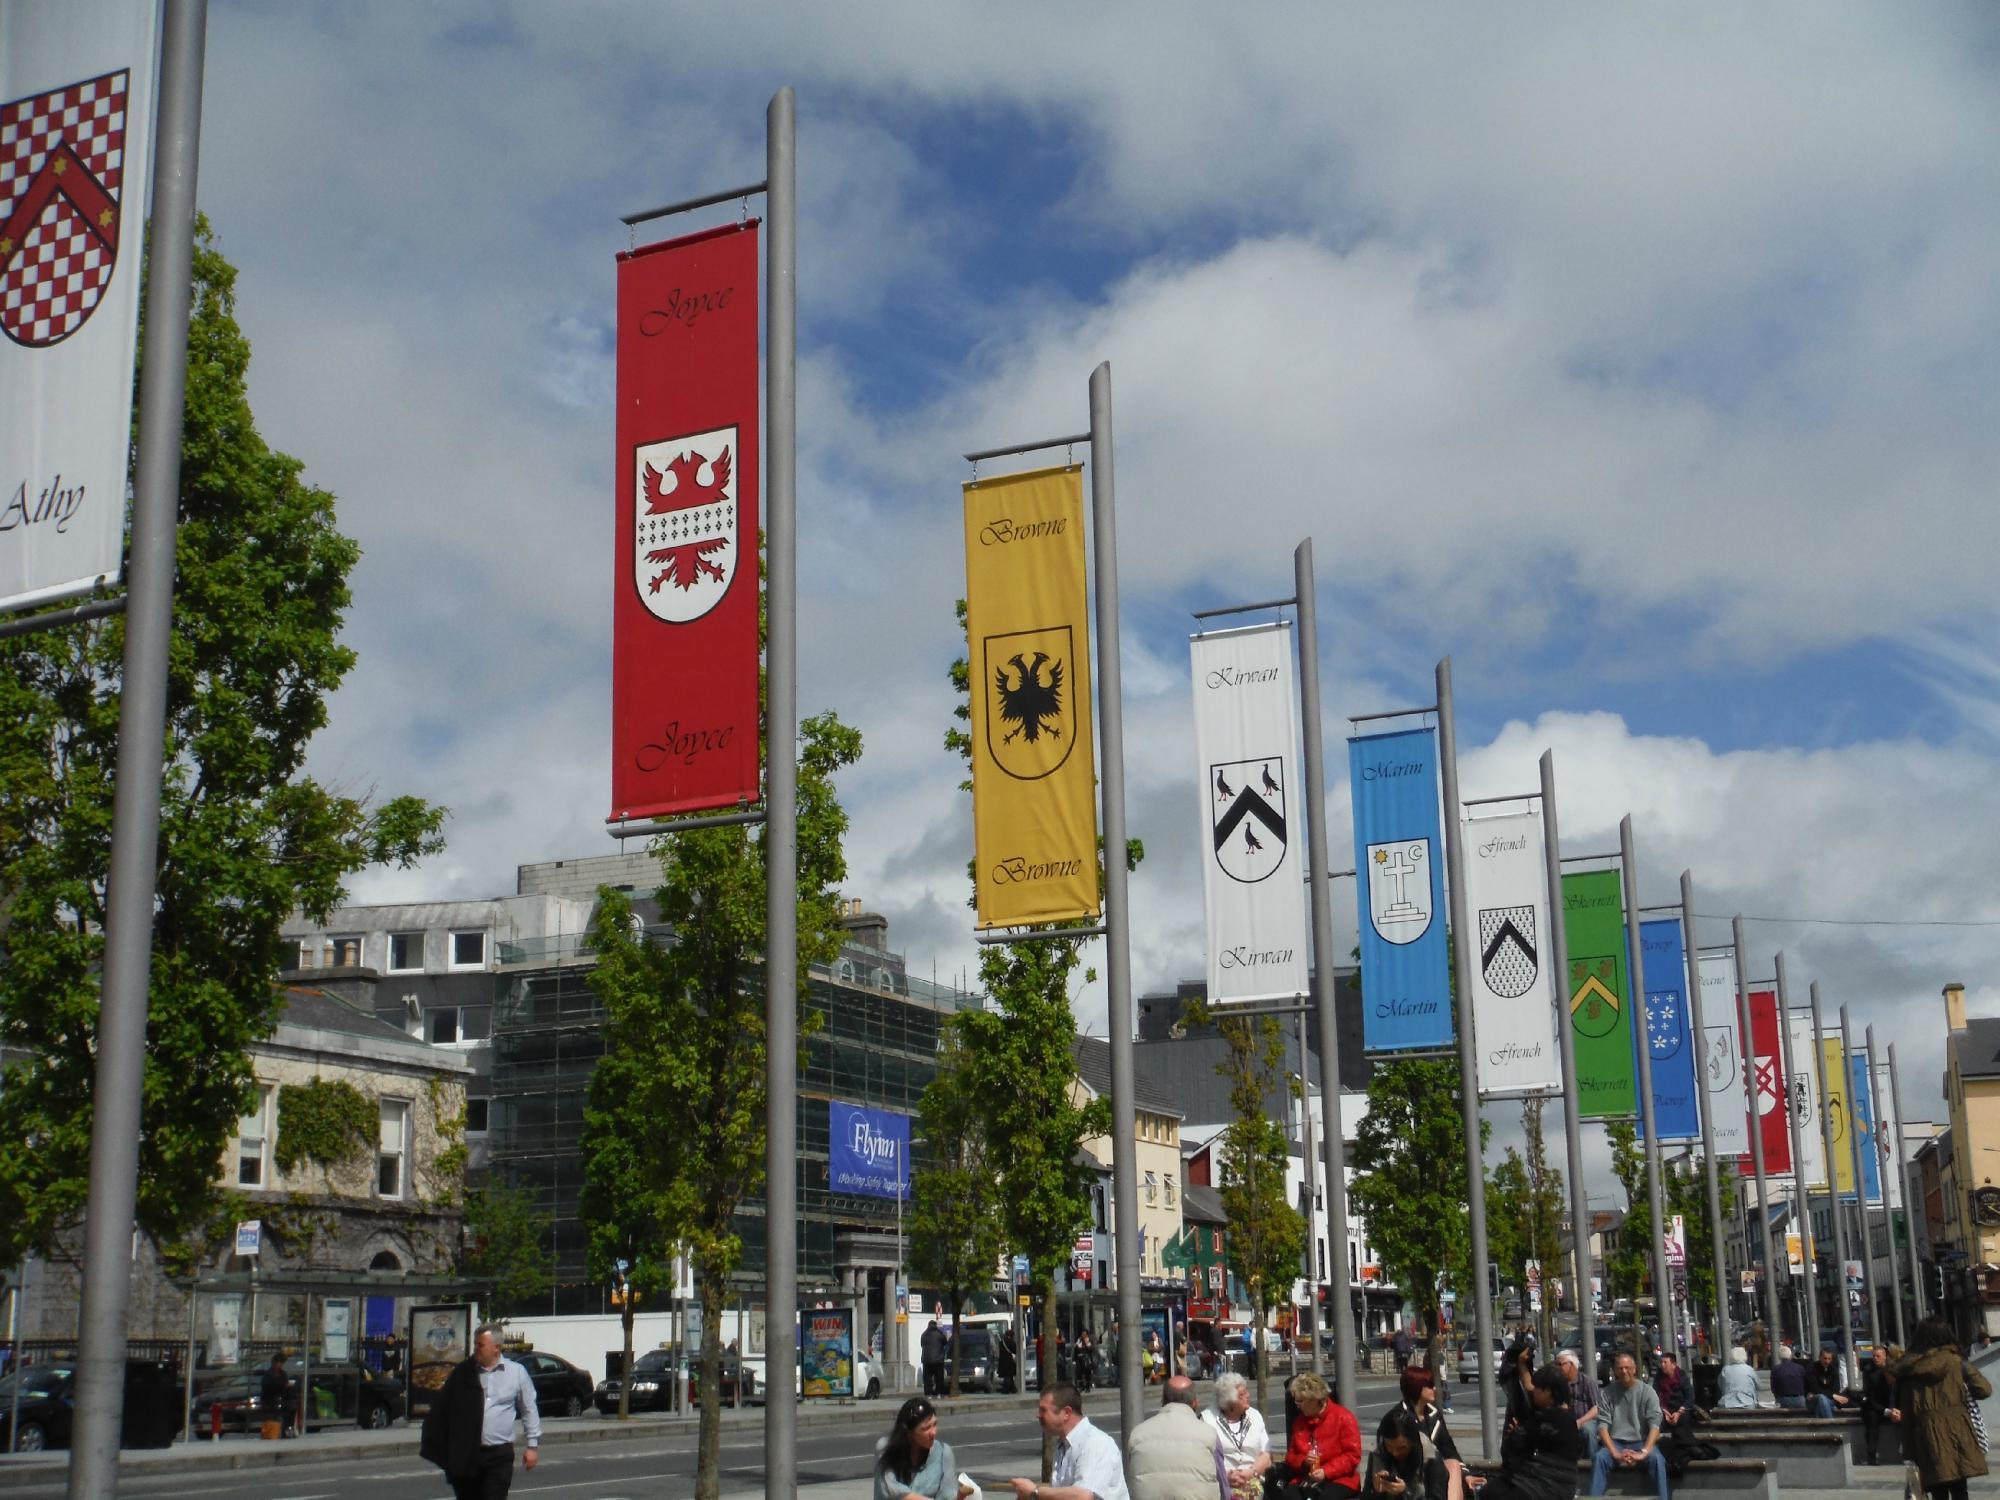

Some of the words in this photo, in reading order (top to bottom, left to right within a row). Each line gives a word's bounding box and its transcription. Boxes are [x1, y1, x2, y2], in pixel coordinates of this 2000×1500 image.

[639, 287, 734, 337] Joyce
[0, 474, 85, 534] Athy
[980, 518, 1067, 546] Browne
[1206, 666, 1278, 690] Kirwan
[635, 720, 734, 773] Joyce
[1362, 760, 1423, 781] Martin
[991, 856, 1082, 885] Browne
[1218, 945, 1293, 969] Kirwan
[1375, 998, 1438, 1019] Martin
[1489, 1041, 1542, 1067] Ffrench
[853, 1122, 895, 1166] Flynn
[813, 1318, 843, 1330] WIN
